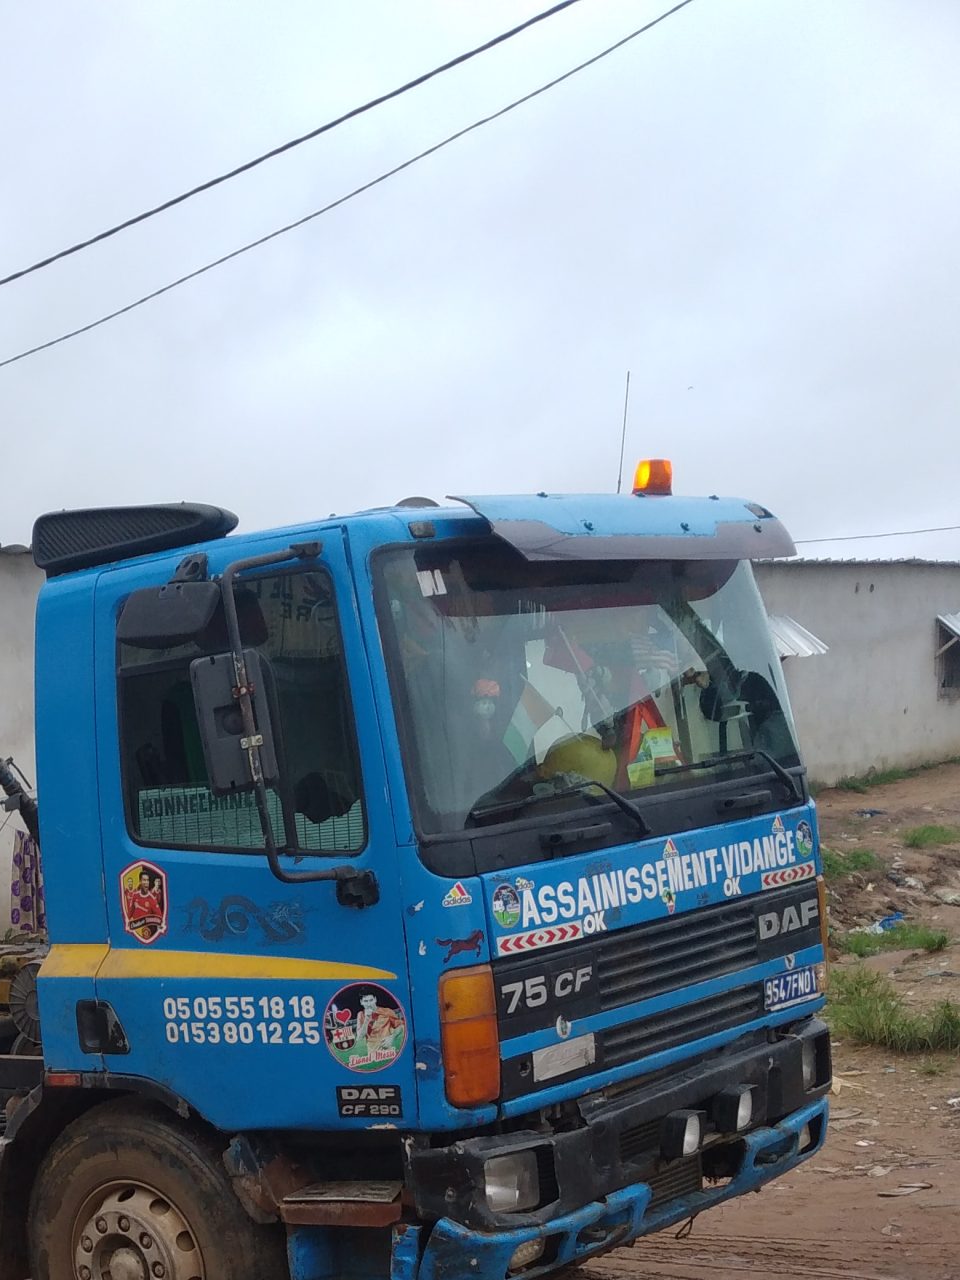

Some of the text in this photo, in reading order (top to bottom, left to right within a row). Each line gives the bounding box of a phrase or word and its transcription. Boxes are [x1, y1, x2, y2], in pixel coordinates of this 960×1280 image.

[723, 876, 742, 898] OK
[443, 895, 472, 907] adidas
[583, 911, 608, 935] OK
[758, 898, 818, 940] DAF
[501, 966, 592, 1014] 75 CF
[765, 969, 816, 1005] 9547FN01
[341, 1088, 395, 1100] DAF
[341, 1104, 400, 1115] CF 290
